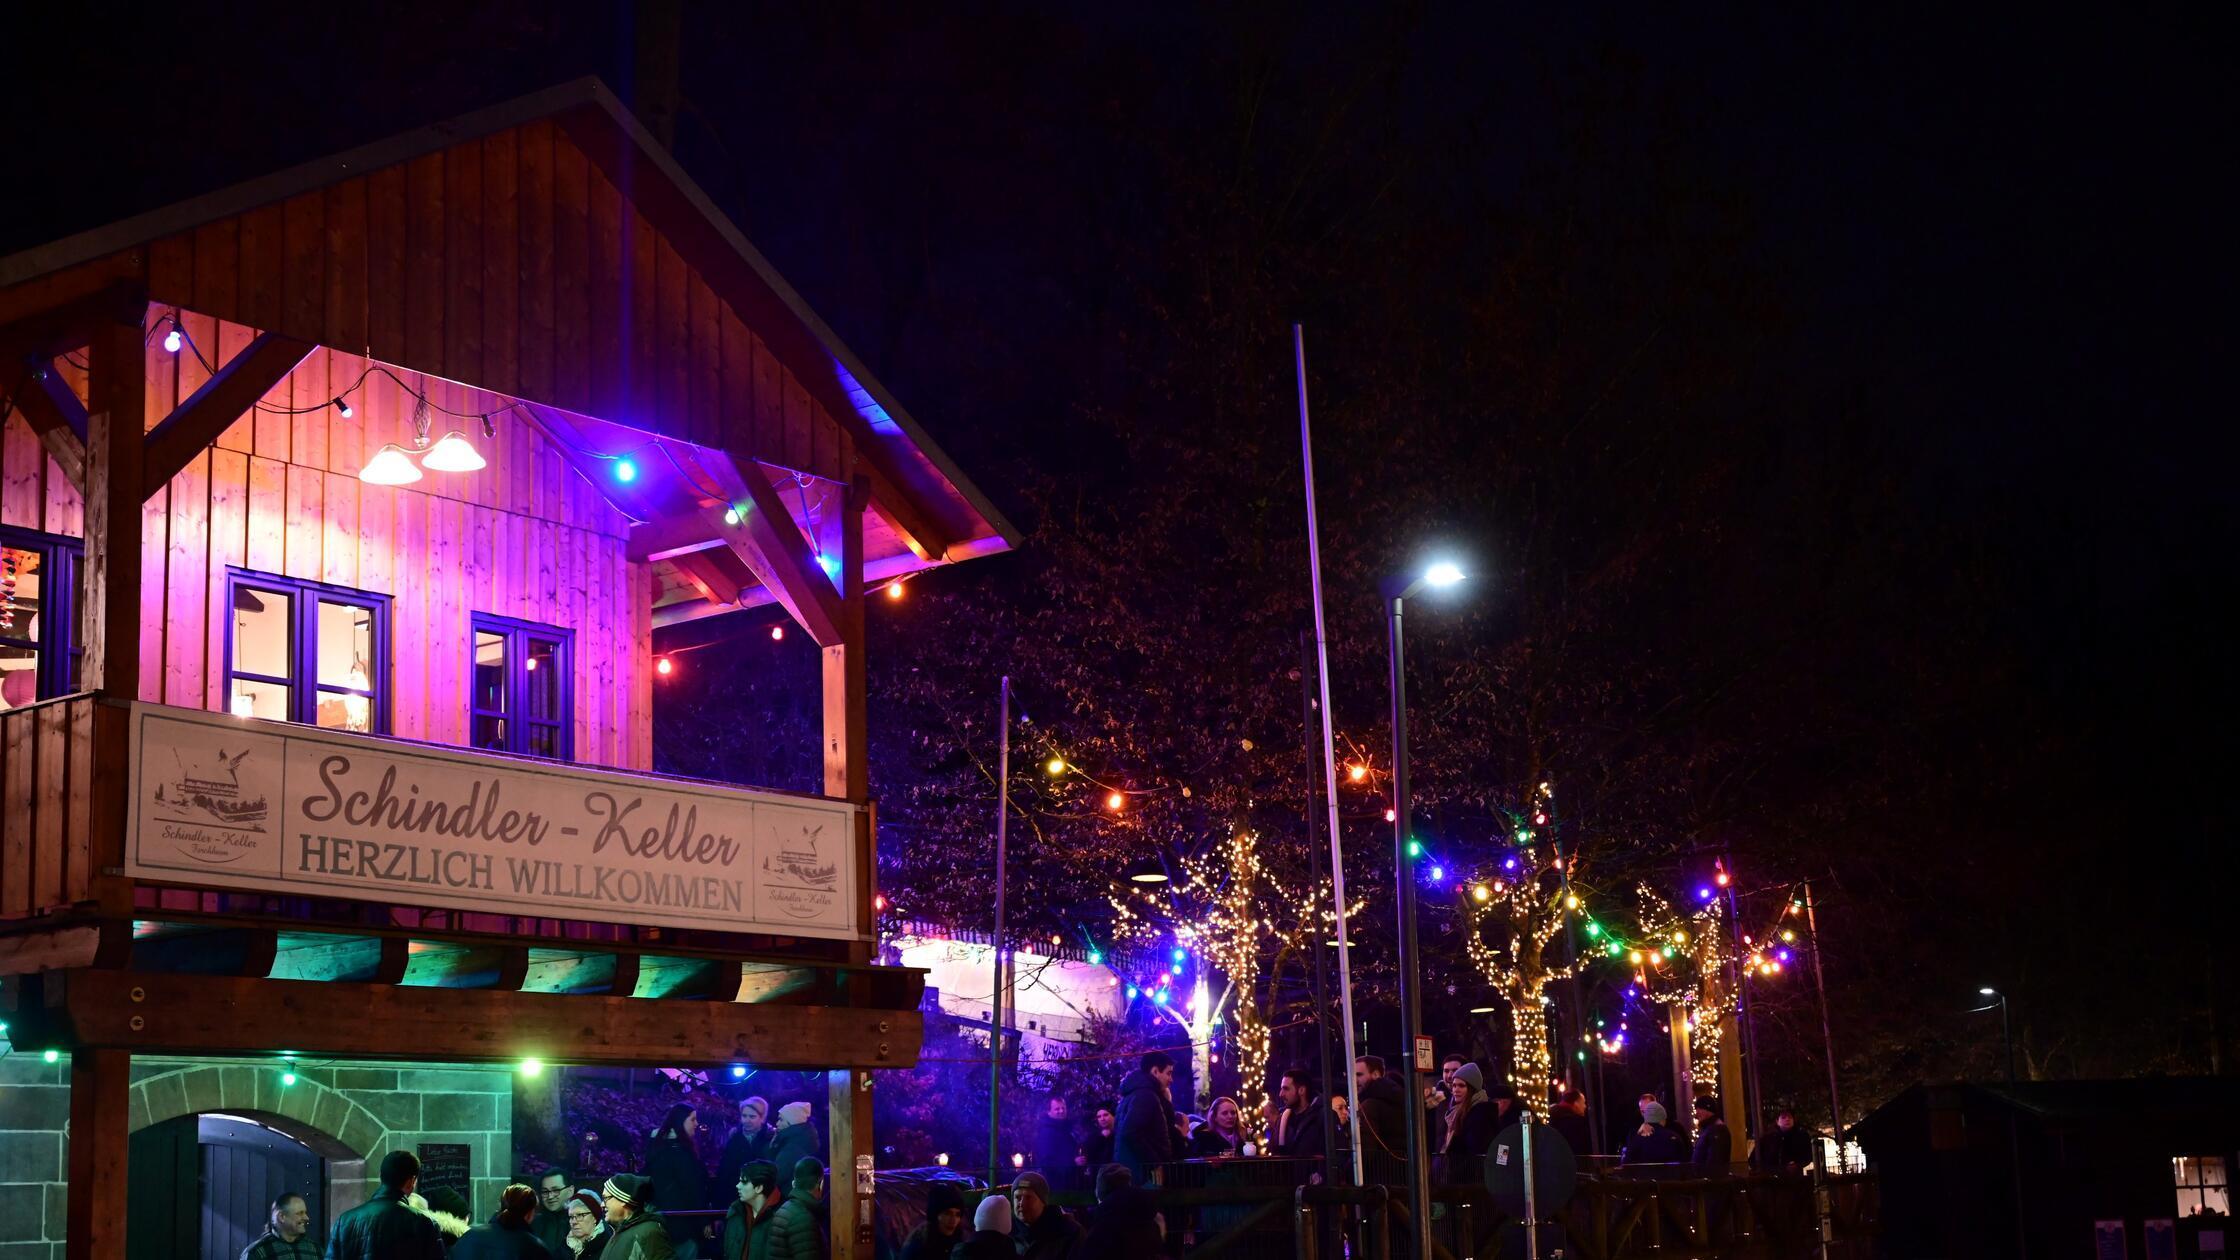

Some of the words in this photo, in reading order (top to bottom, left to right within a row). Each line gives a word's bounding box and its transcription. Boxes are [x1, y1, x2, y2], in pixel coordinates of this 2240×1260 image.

[302, 755, 548, 846] Schindler
[584, 791, 740, 867] Keller
[299, 833, 494, 890] HERZLICH
[505, 856, 743, 912] WILLKOMMEN
